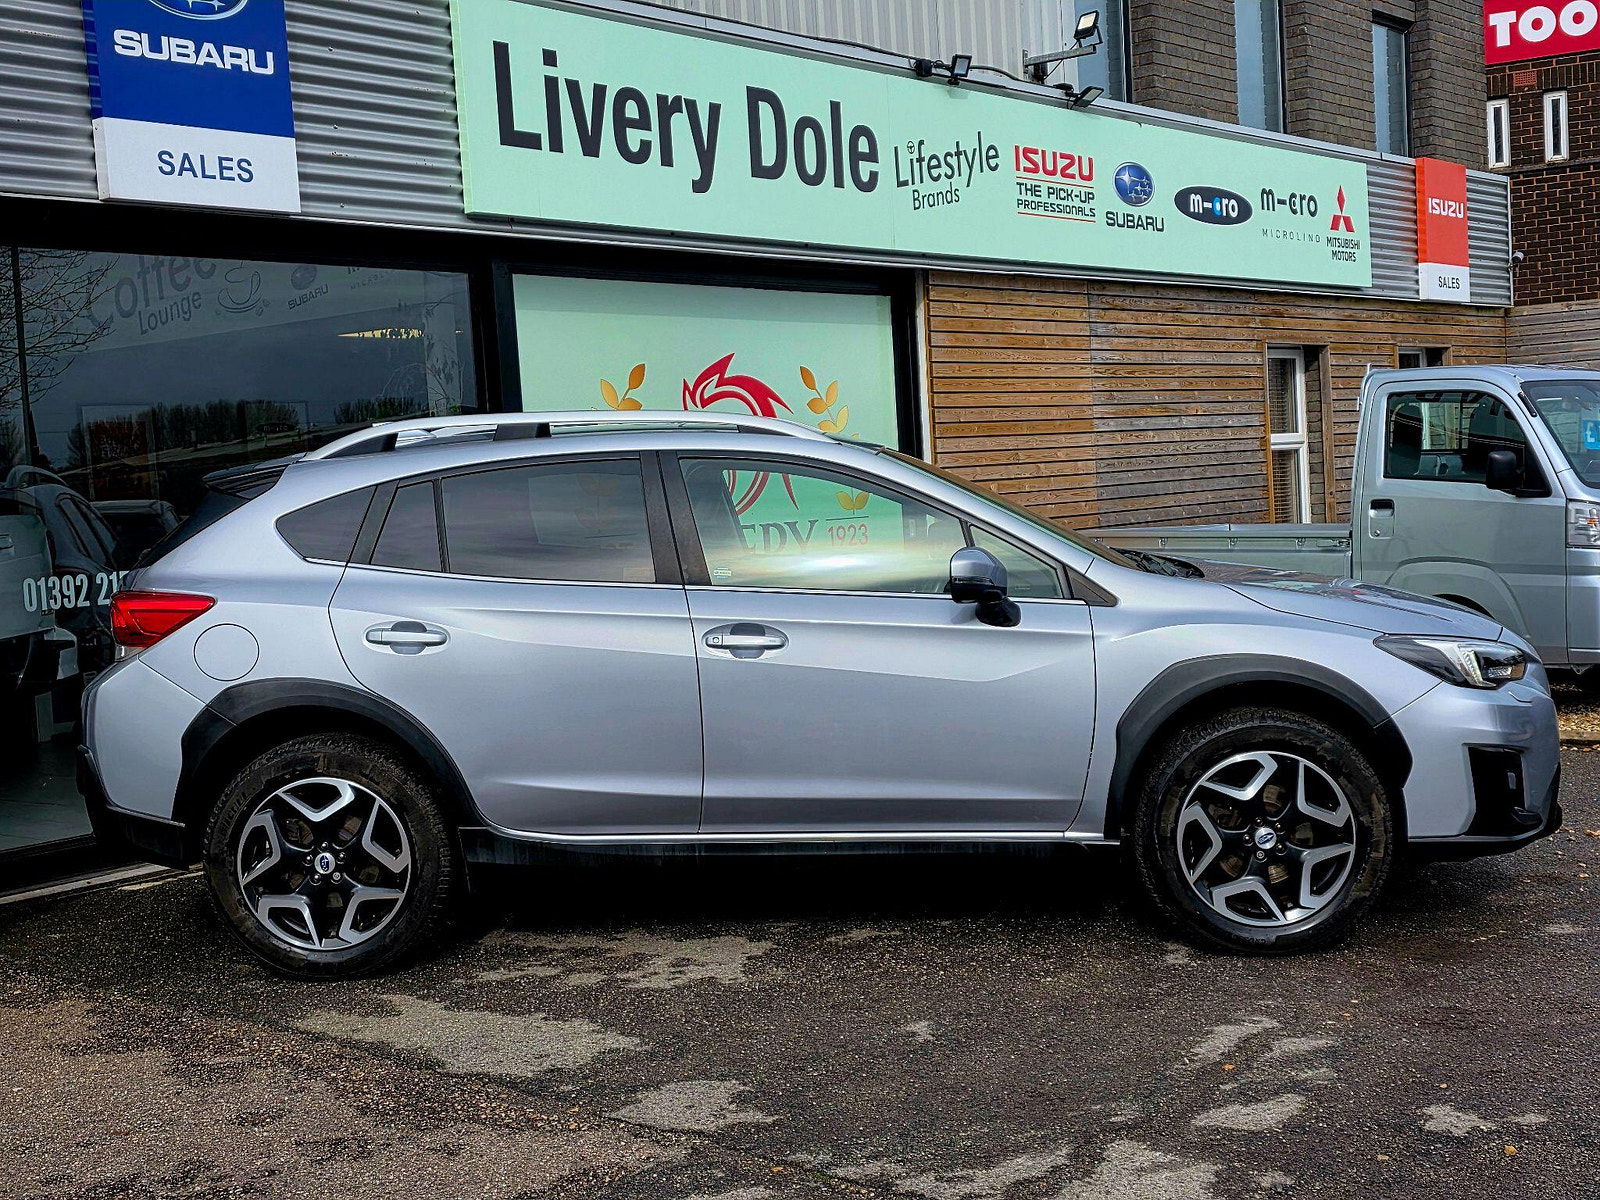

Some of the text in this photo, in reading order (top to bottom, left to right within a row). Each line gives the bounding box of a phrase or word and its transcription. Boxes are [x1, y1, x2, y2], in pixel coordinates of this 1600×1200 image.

[1489, 0, 1598, 47] TOO
[113, 29, 275, 76] SUBARU
[492, 40, 880, 194] Livery Dole
[157, 149, 254, 183] SALES
[894, 131, 1000, 188] Lifestyle
[1014, 145, 1094, 182] ISUZU
[912, 182, 960, 210] Brands
[1016, 182, 1095, 204] THE PICK-UP
[1016, 198, 1096, 218] PROFESSIONALS
[1428, 197, 1464, 219] ISUZU
[1105, 211, 1165, 233] SUBARU
[1262, 228, 1322, 243] MICROLINO
[1326, 237, 1361, 250] MITSUBISHI
[1331, 250, 1357, 263] MOTORS
[287, 283, 329, 310] SUBARU
[1438, 276, 1461, 290] SALES
[138, 291, 202, 335] Lounge
[827, 522, 869, 547] 1923
[23, 573, 90, 612] 01392
